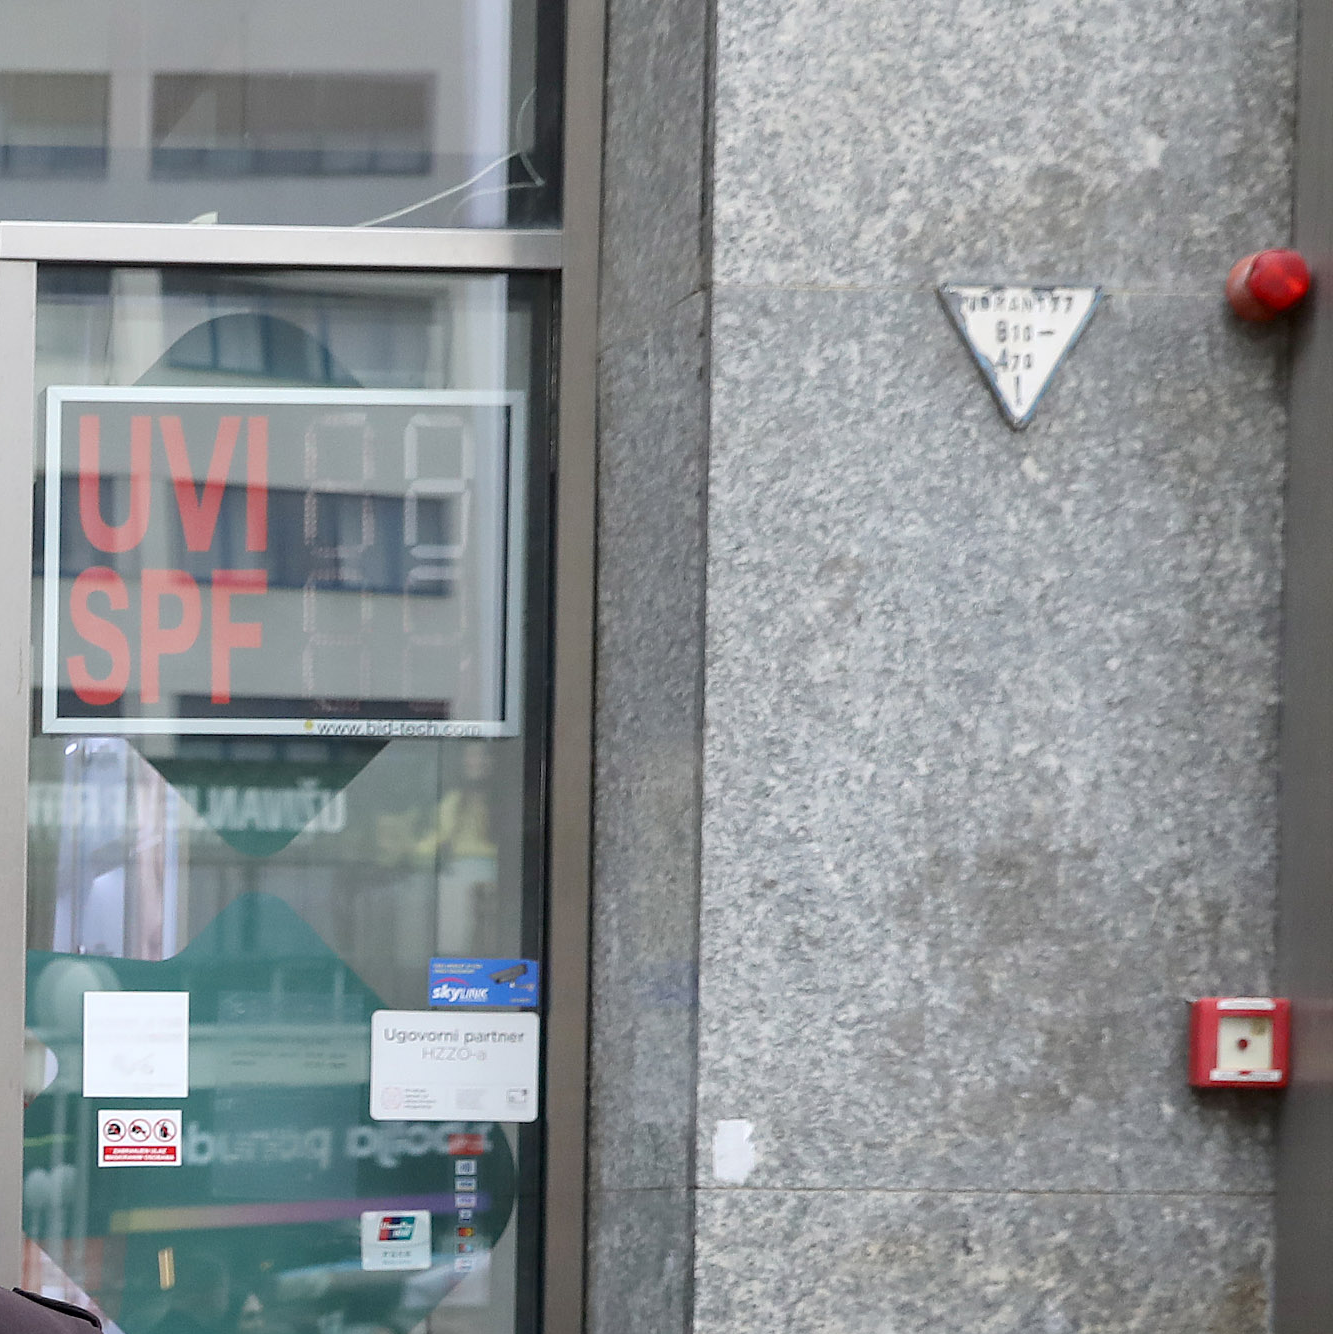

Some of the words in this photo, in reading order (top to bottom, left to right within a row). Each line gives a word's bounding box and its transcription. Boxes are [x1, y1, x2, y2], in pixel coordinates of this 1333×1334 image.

[78, 414, 269, 554] UVI
[66, 566, 268, 706] SPF
[383, 1028, 460, 1044] Ugovorni
[463, 1031, 525, 1045] partner
